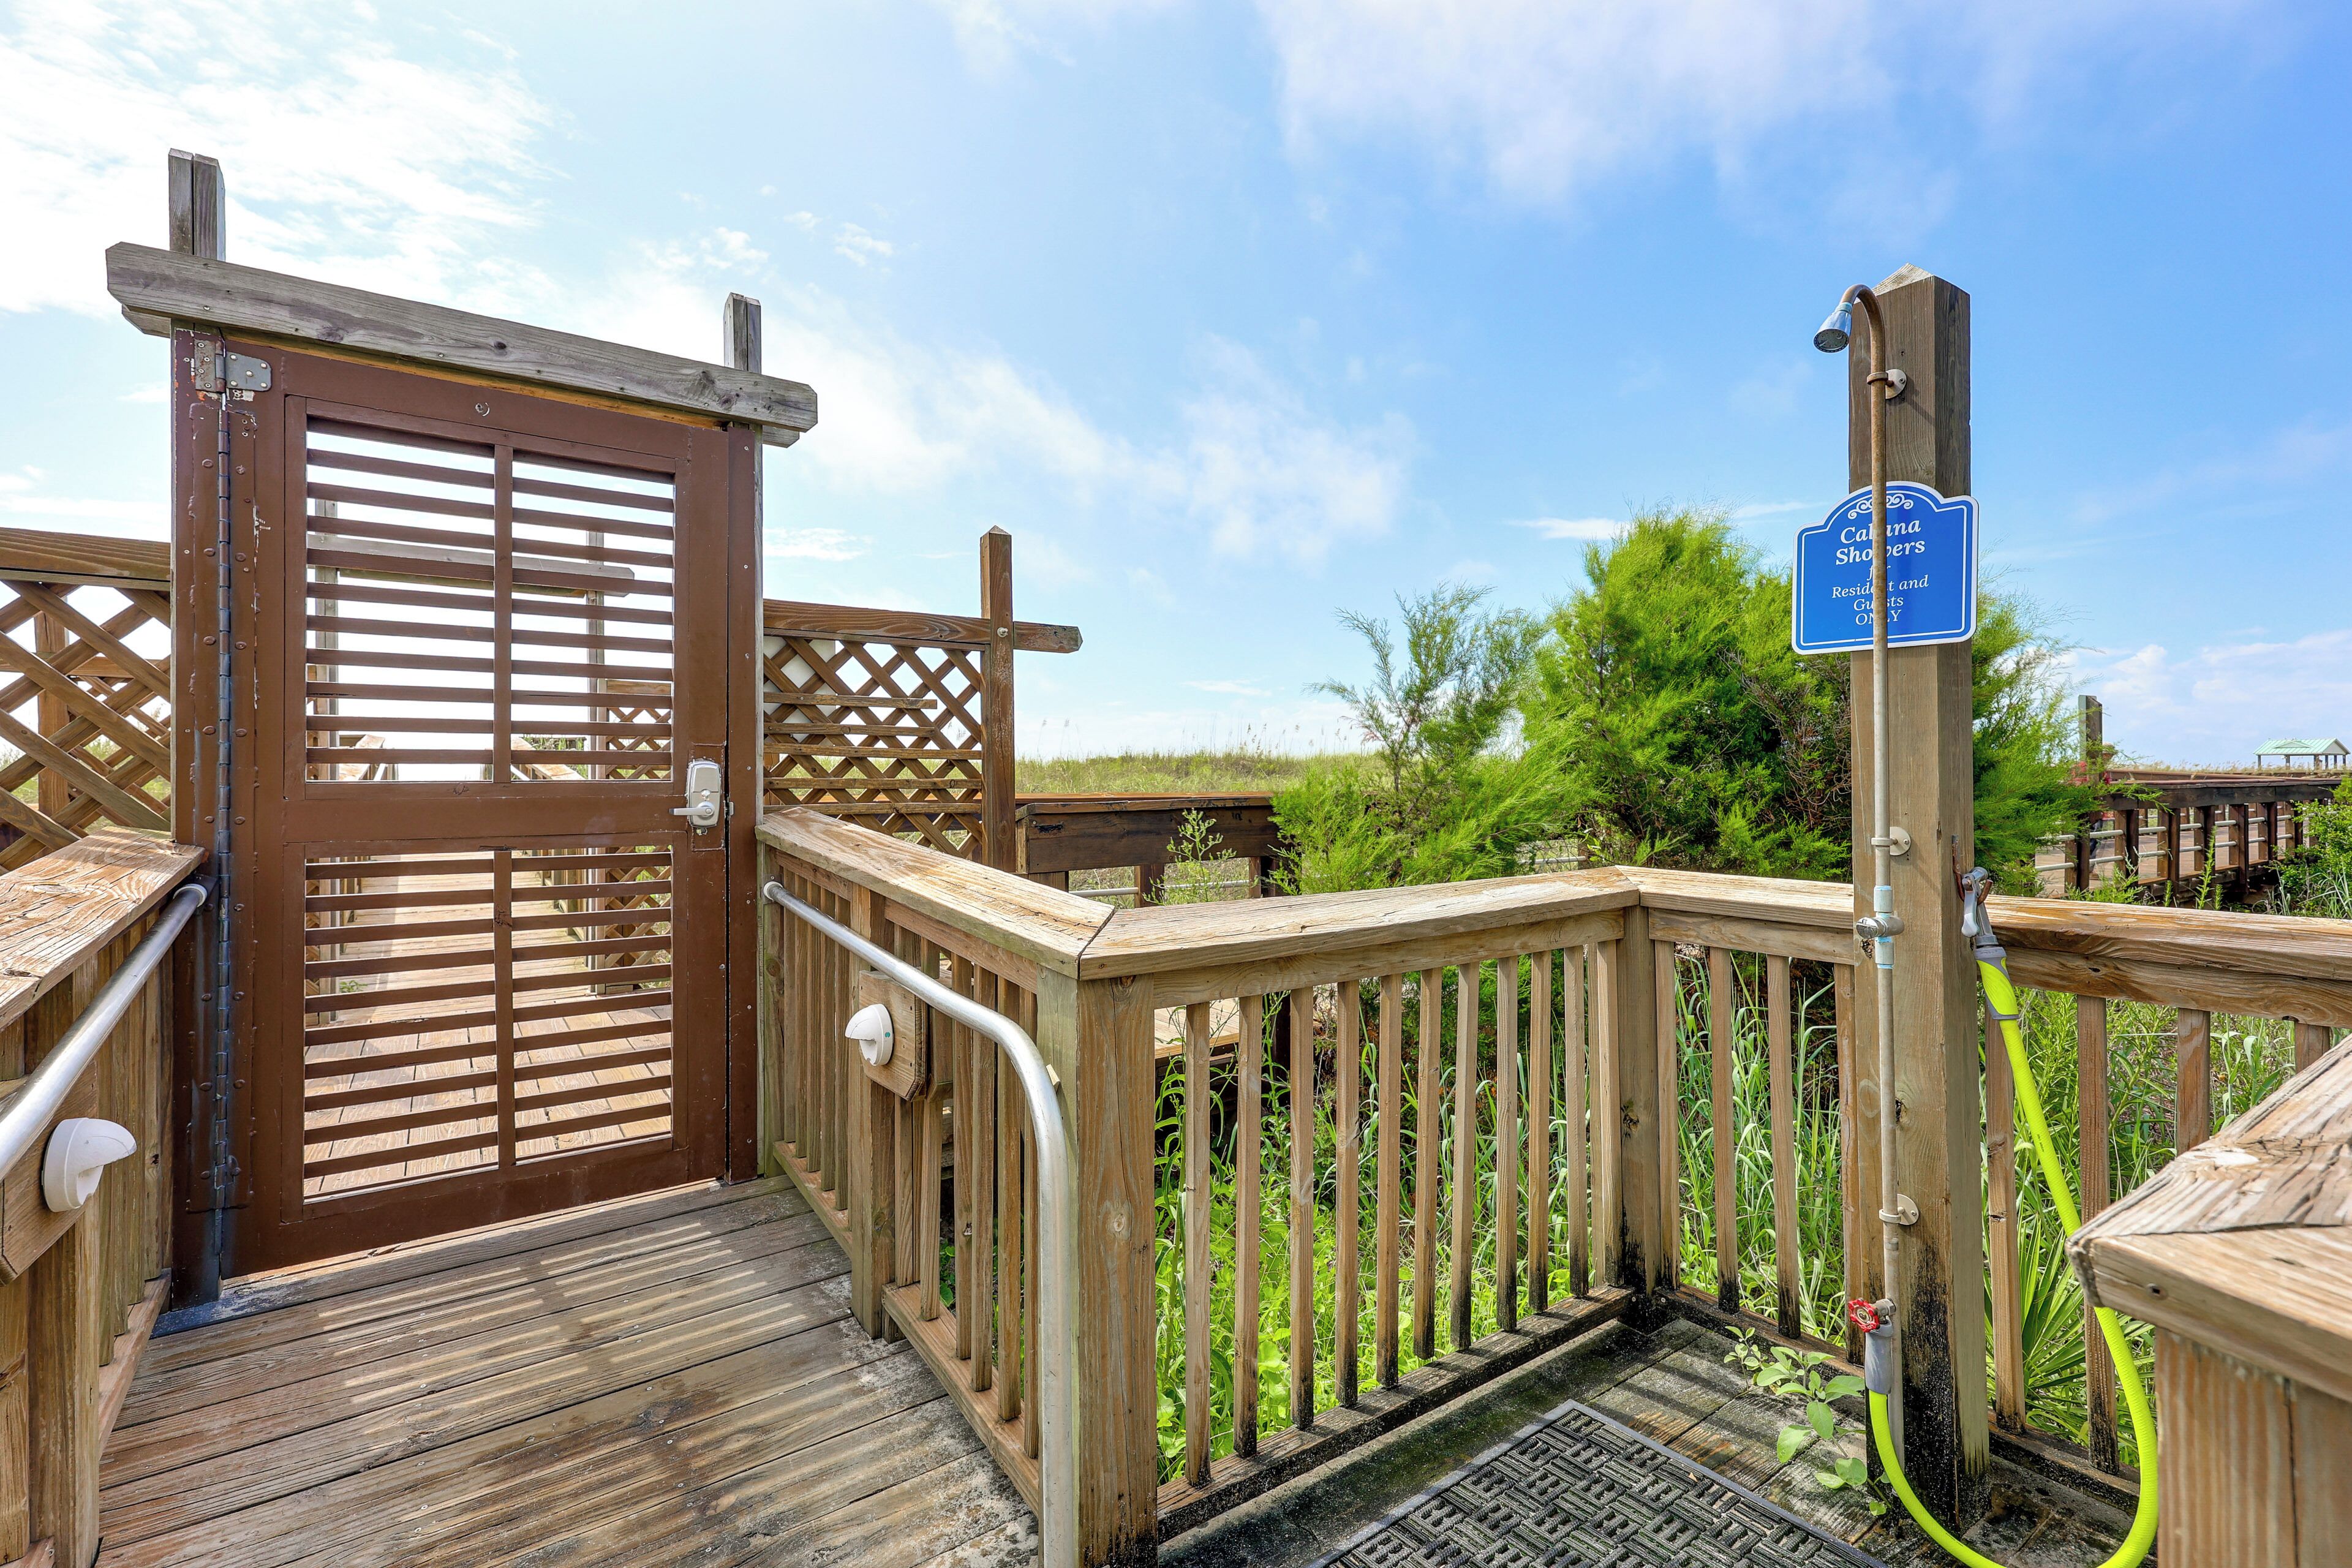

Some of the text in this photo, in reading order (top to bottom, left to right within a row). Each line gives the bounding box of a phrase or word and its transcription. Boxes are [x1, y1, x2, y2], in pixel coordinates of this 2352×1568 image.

[1840, 520, 1921, 544] Cana
[1835, 540, 1926, 565] Shoers
[1831, 575, 1929, 598] Residt and
[1853, 596, 1904, 611] Guts
